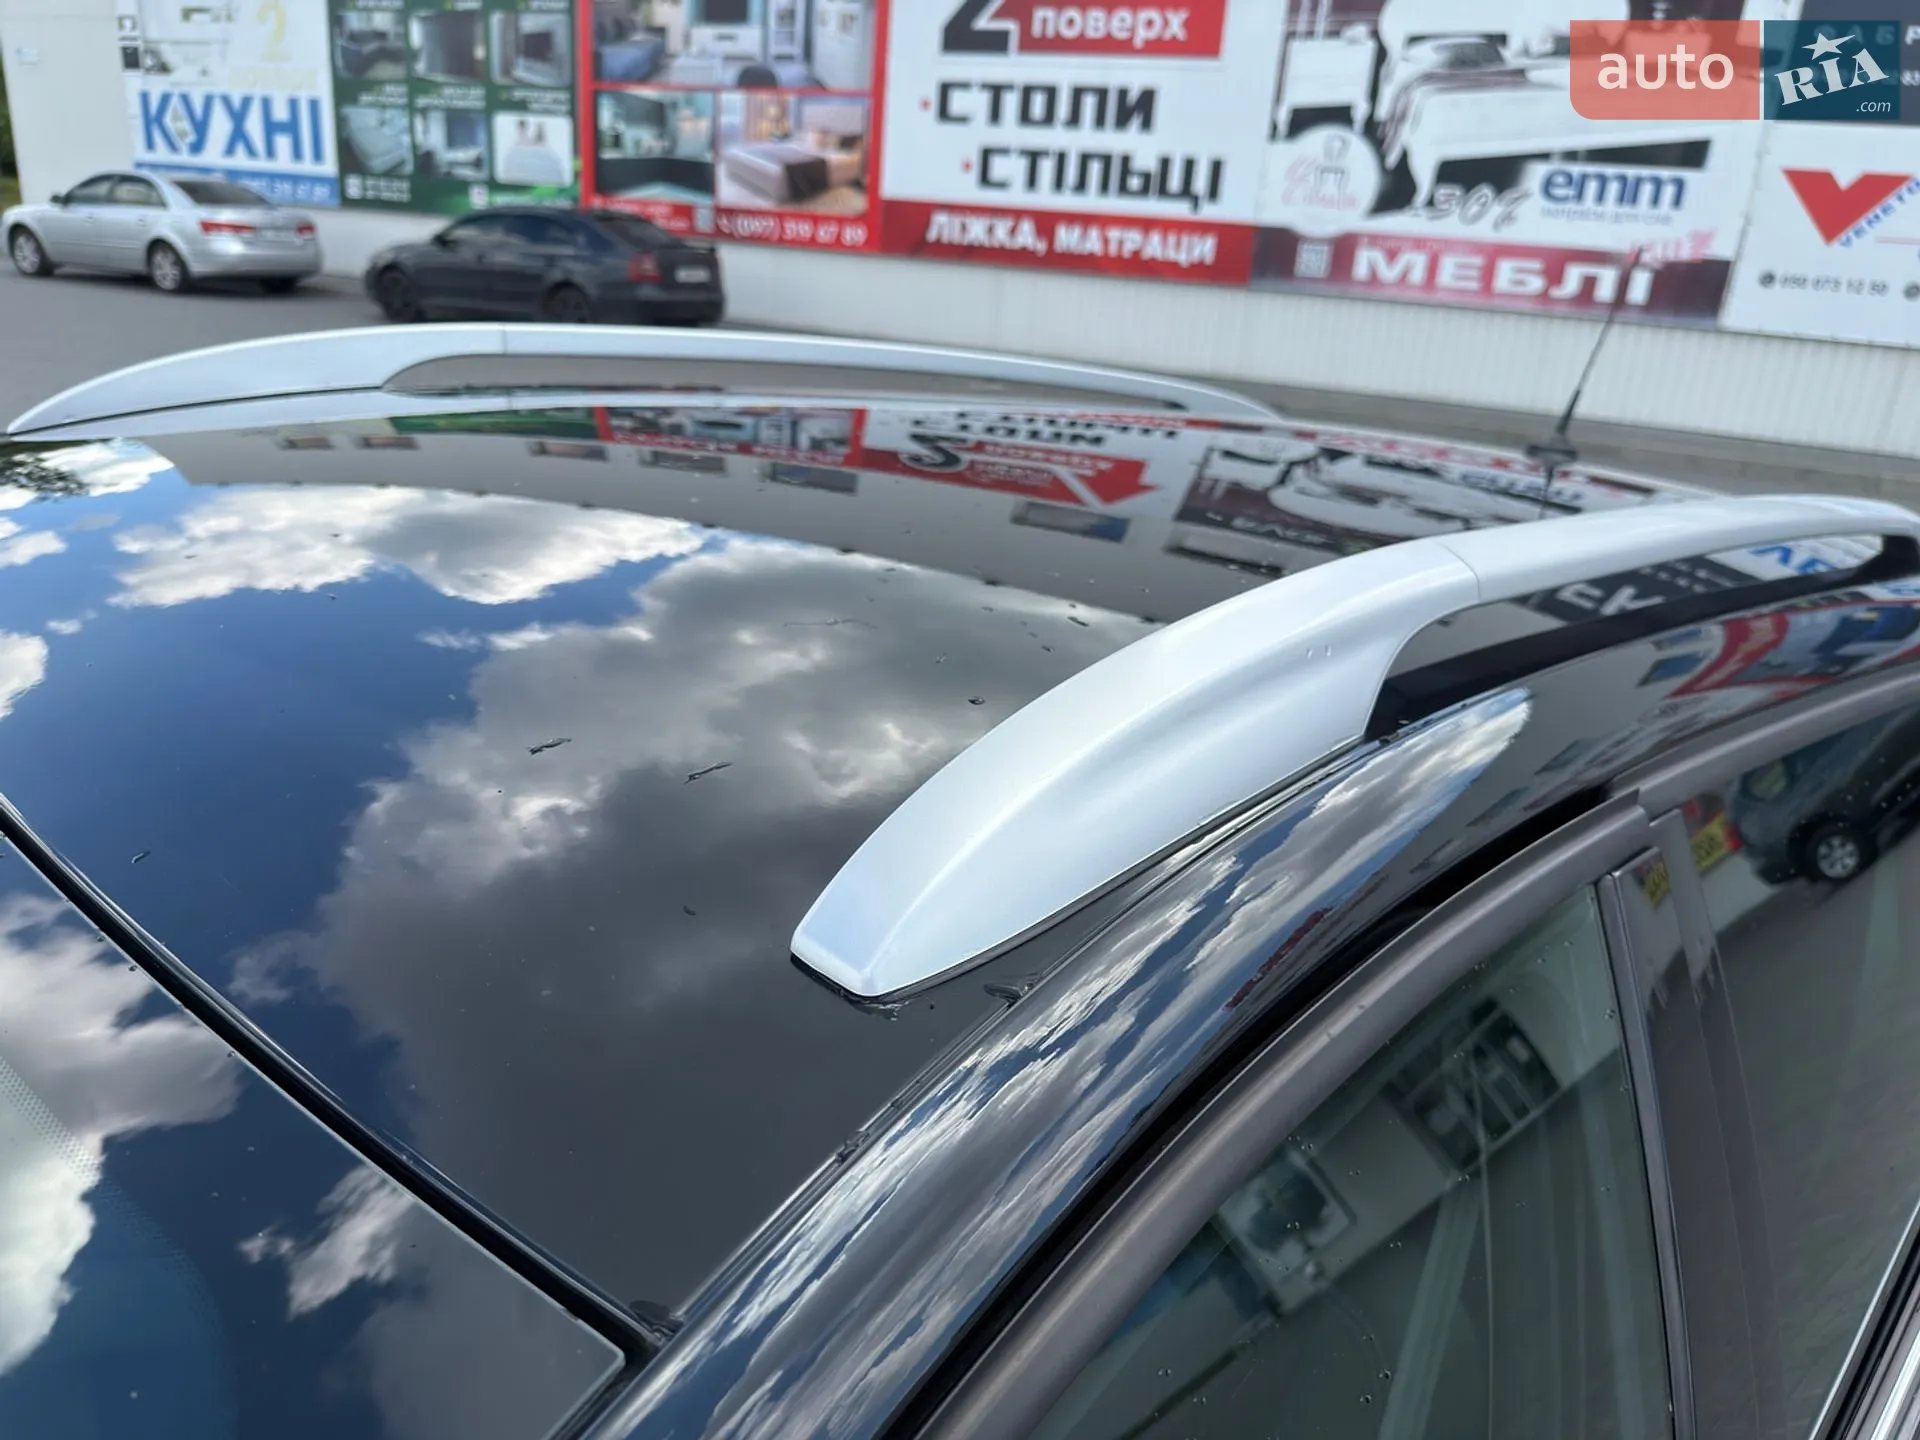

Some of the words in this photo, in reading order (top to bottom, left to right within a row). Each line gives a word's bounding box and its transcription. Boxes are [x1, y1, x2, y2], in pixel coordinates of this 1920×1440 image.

[1031, 5, 1190, 49] поверх
[139, 91, 325, 165] КУХНІ
[936, 80, 1158, 134] СТОЛИ
[977, 145, 1224, 214] СТІЛЬЦІ
[926, 210, 1049, 256] ЛІЖКА,
[1053, 220, 1218, 267] МАТРАЦИ
[1352, 246, 1655, 306] МЕБЛІ
